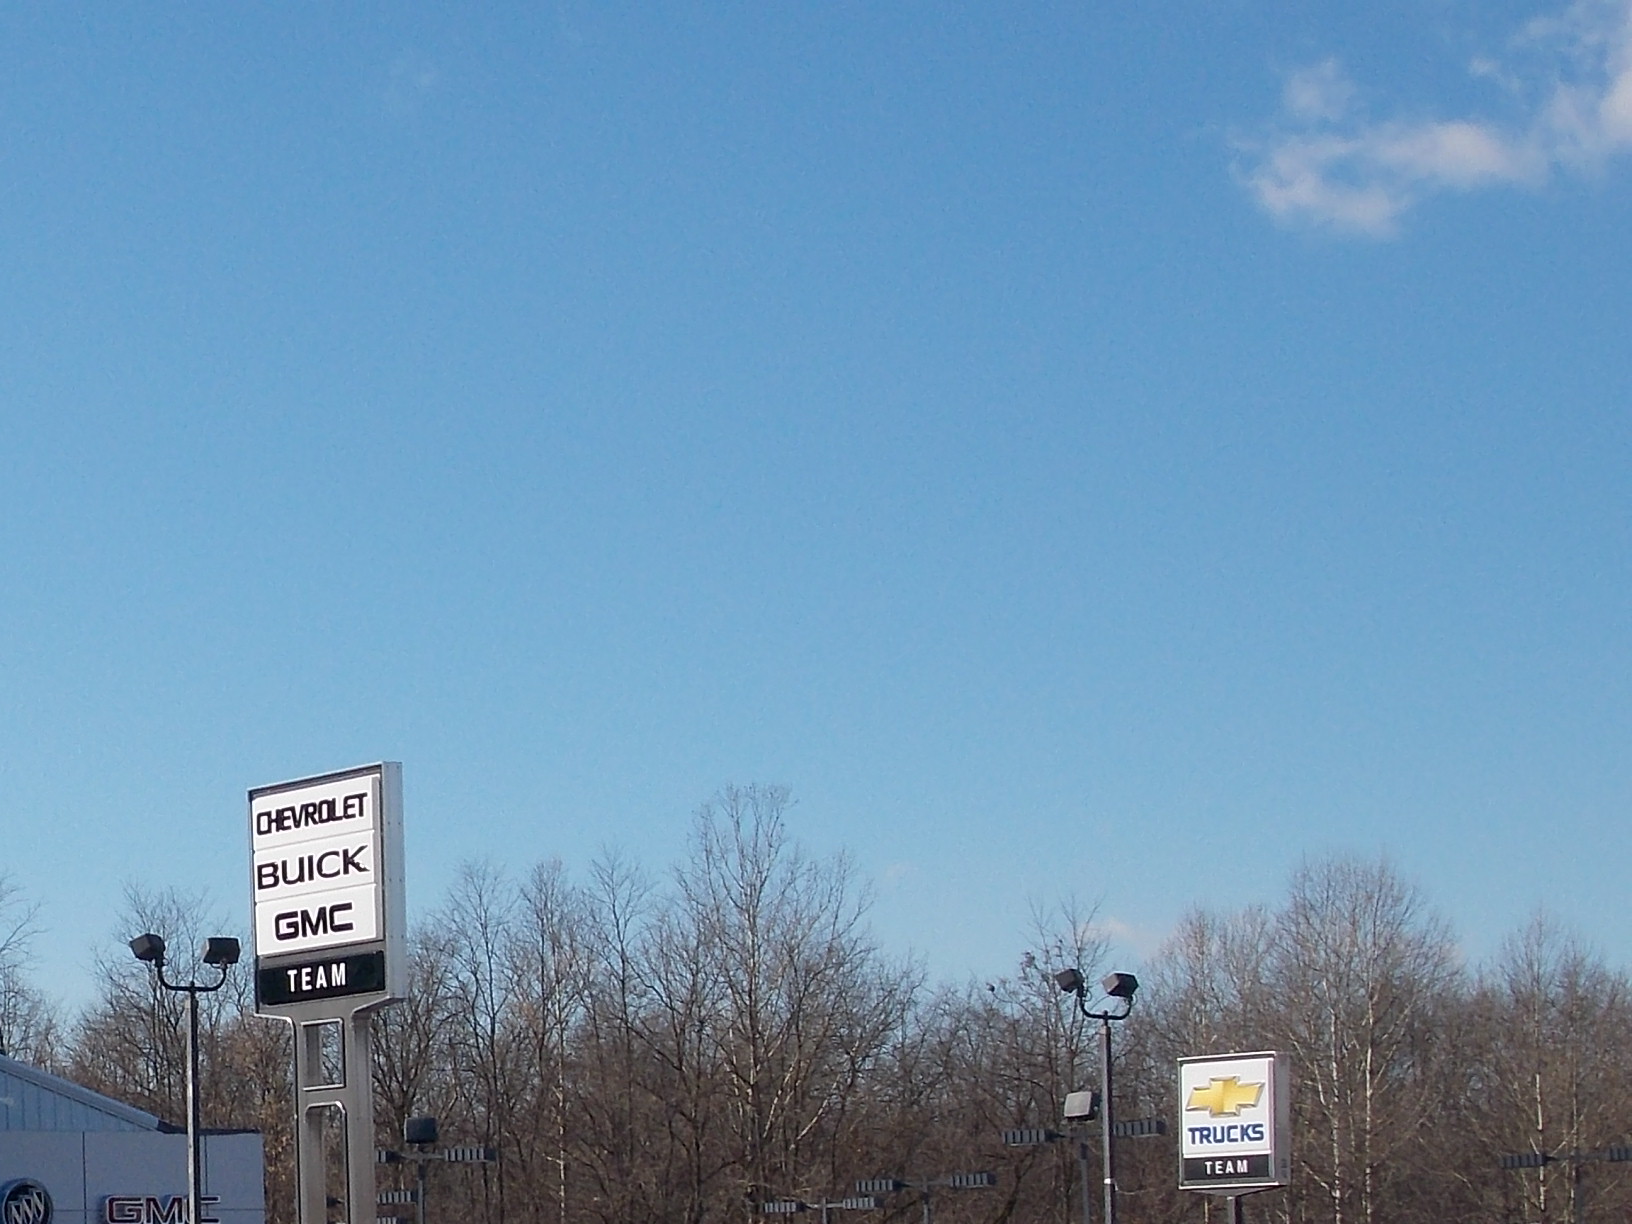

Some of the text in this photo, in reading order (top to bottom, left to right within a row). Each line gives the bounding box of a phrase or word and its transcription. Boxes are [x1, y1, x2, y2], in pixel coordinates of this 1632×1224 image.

[256, 792, 368, 836] CHEVROLET
[257, 845, 371, 890] BUICK
[274, 902, 354, 941] GMC
[287, 962, 347, 993] TEAM
[1188, 1123, 1264, 1145] TRUCKS
[1205, 1159, 1248, 1175] TEAM
